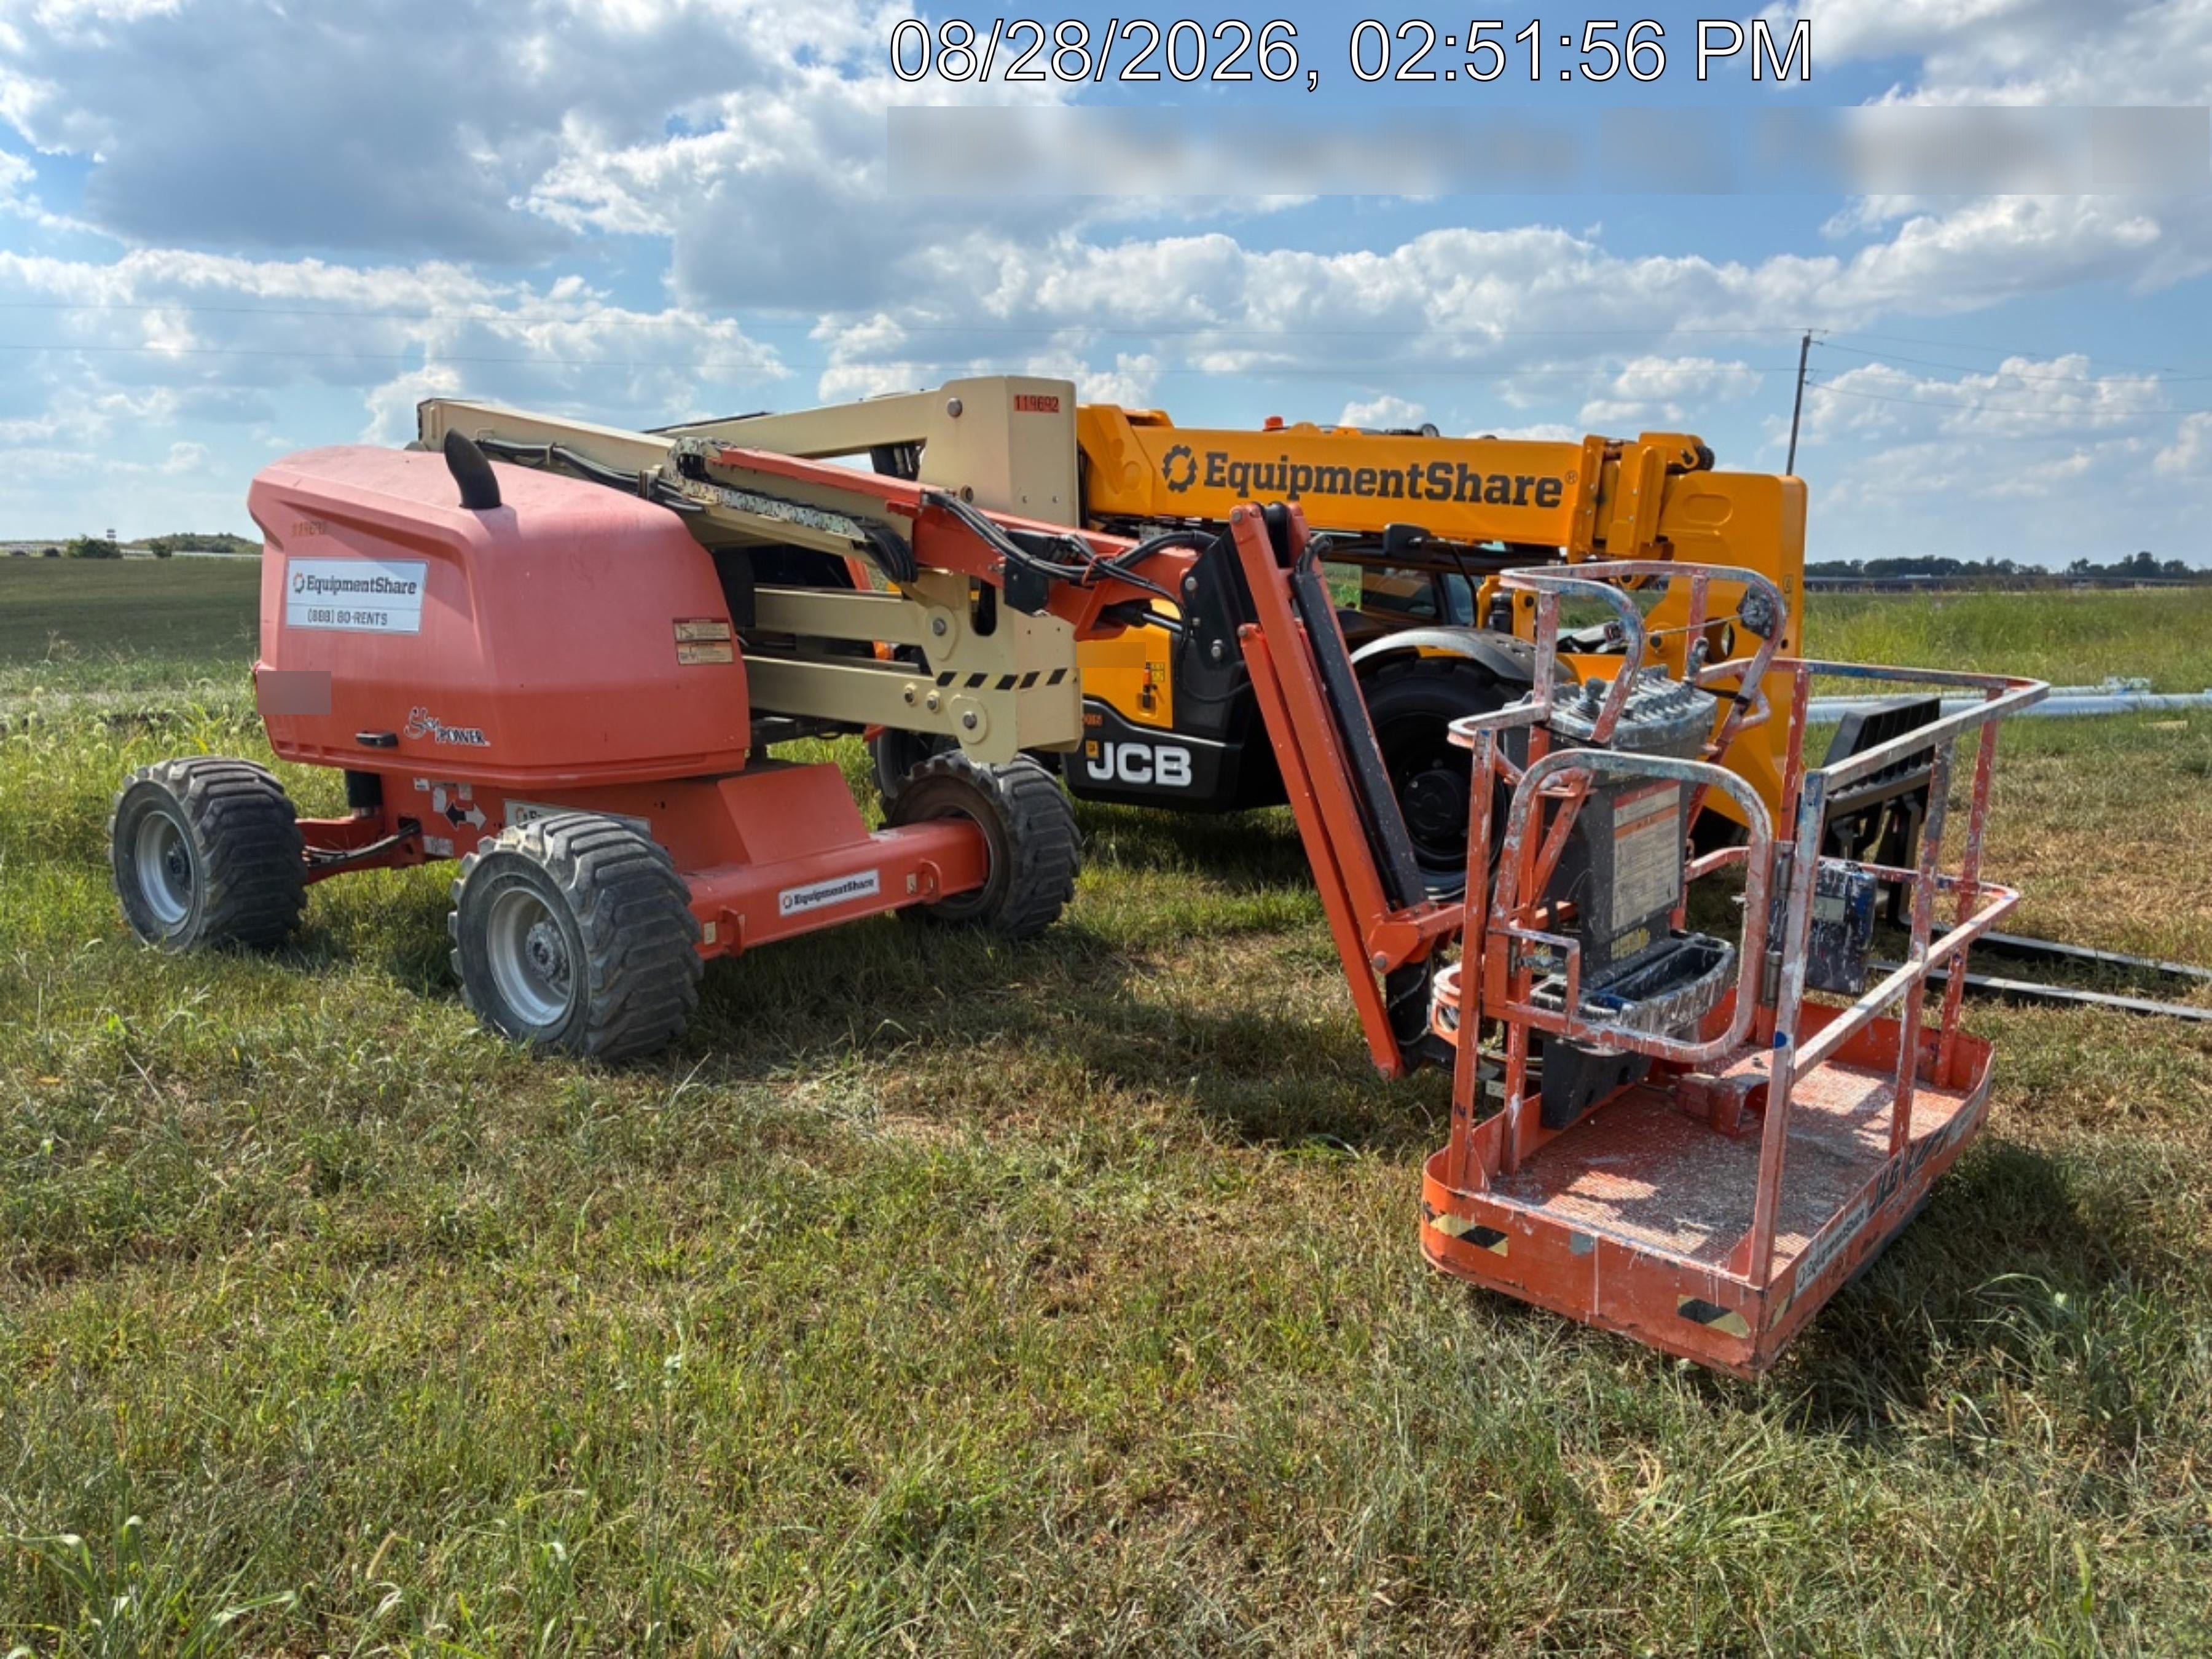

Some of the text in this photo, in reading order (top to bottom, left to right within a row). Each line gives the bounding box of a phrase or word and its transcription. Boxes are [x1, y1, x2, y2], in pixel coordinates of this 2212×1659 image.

[306, 575, 418, 596] EquipmentShare
[1086, 740, 1193, 786] JCB
[794, 877, 875, 904] EquipmentShare
